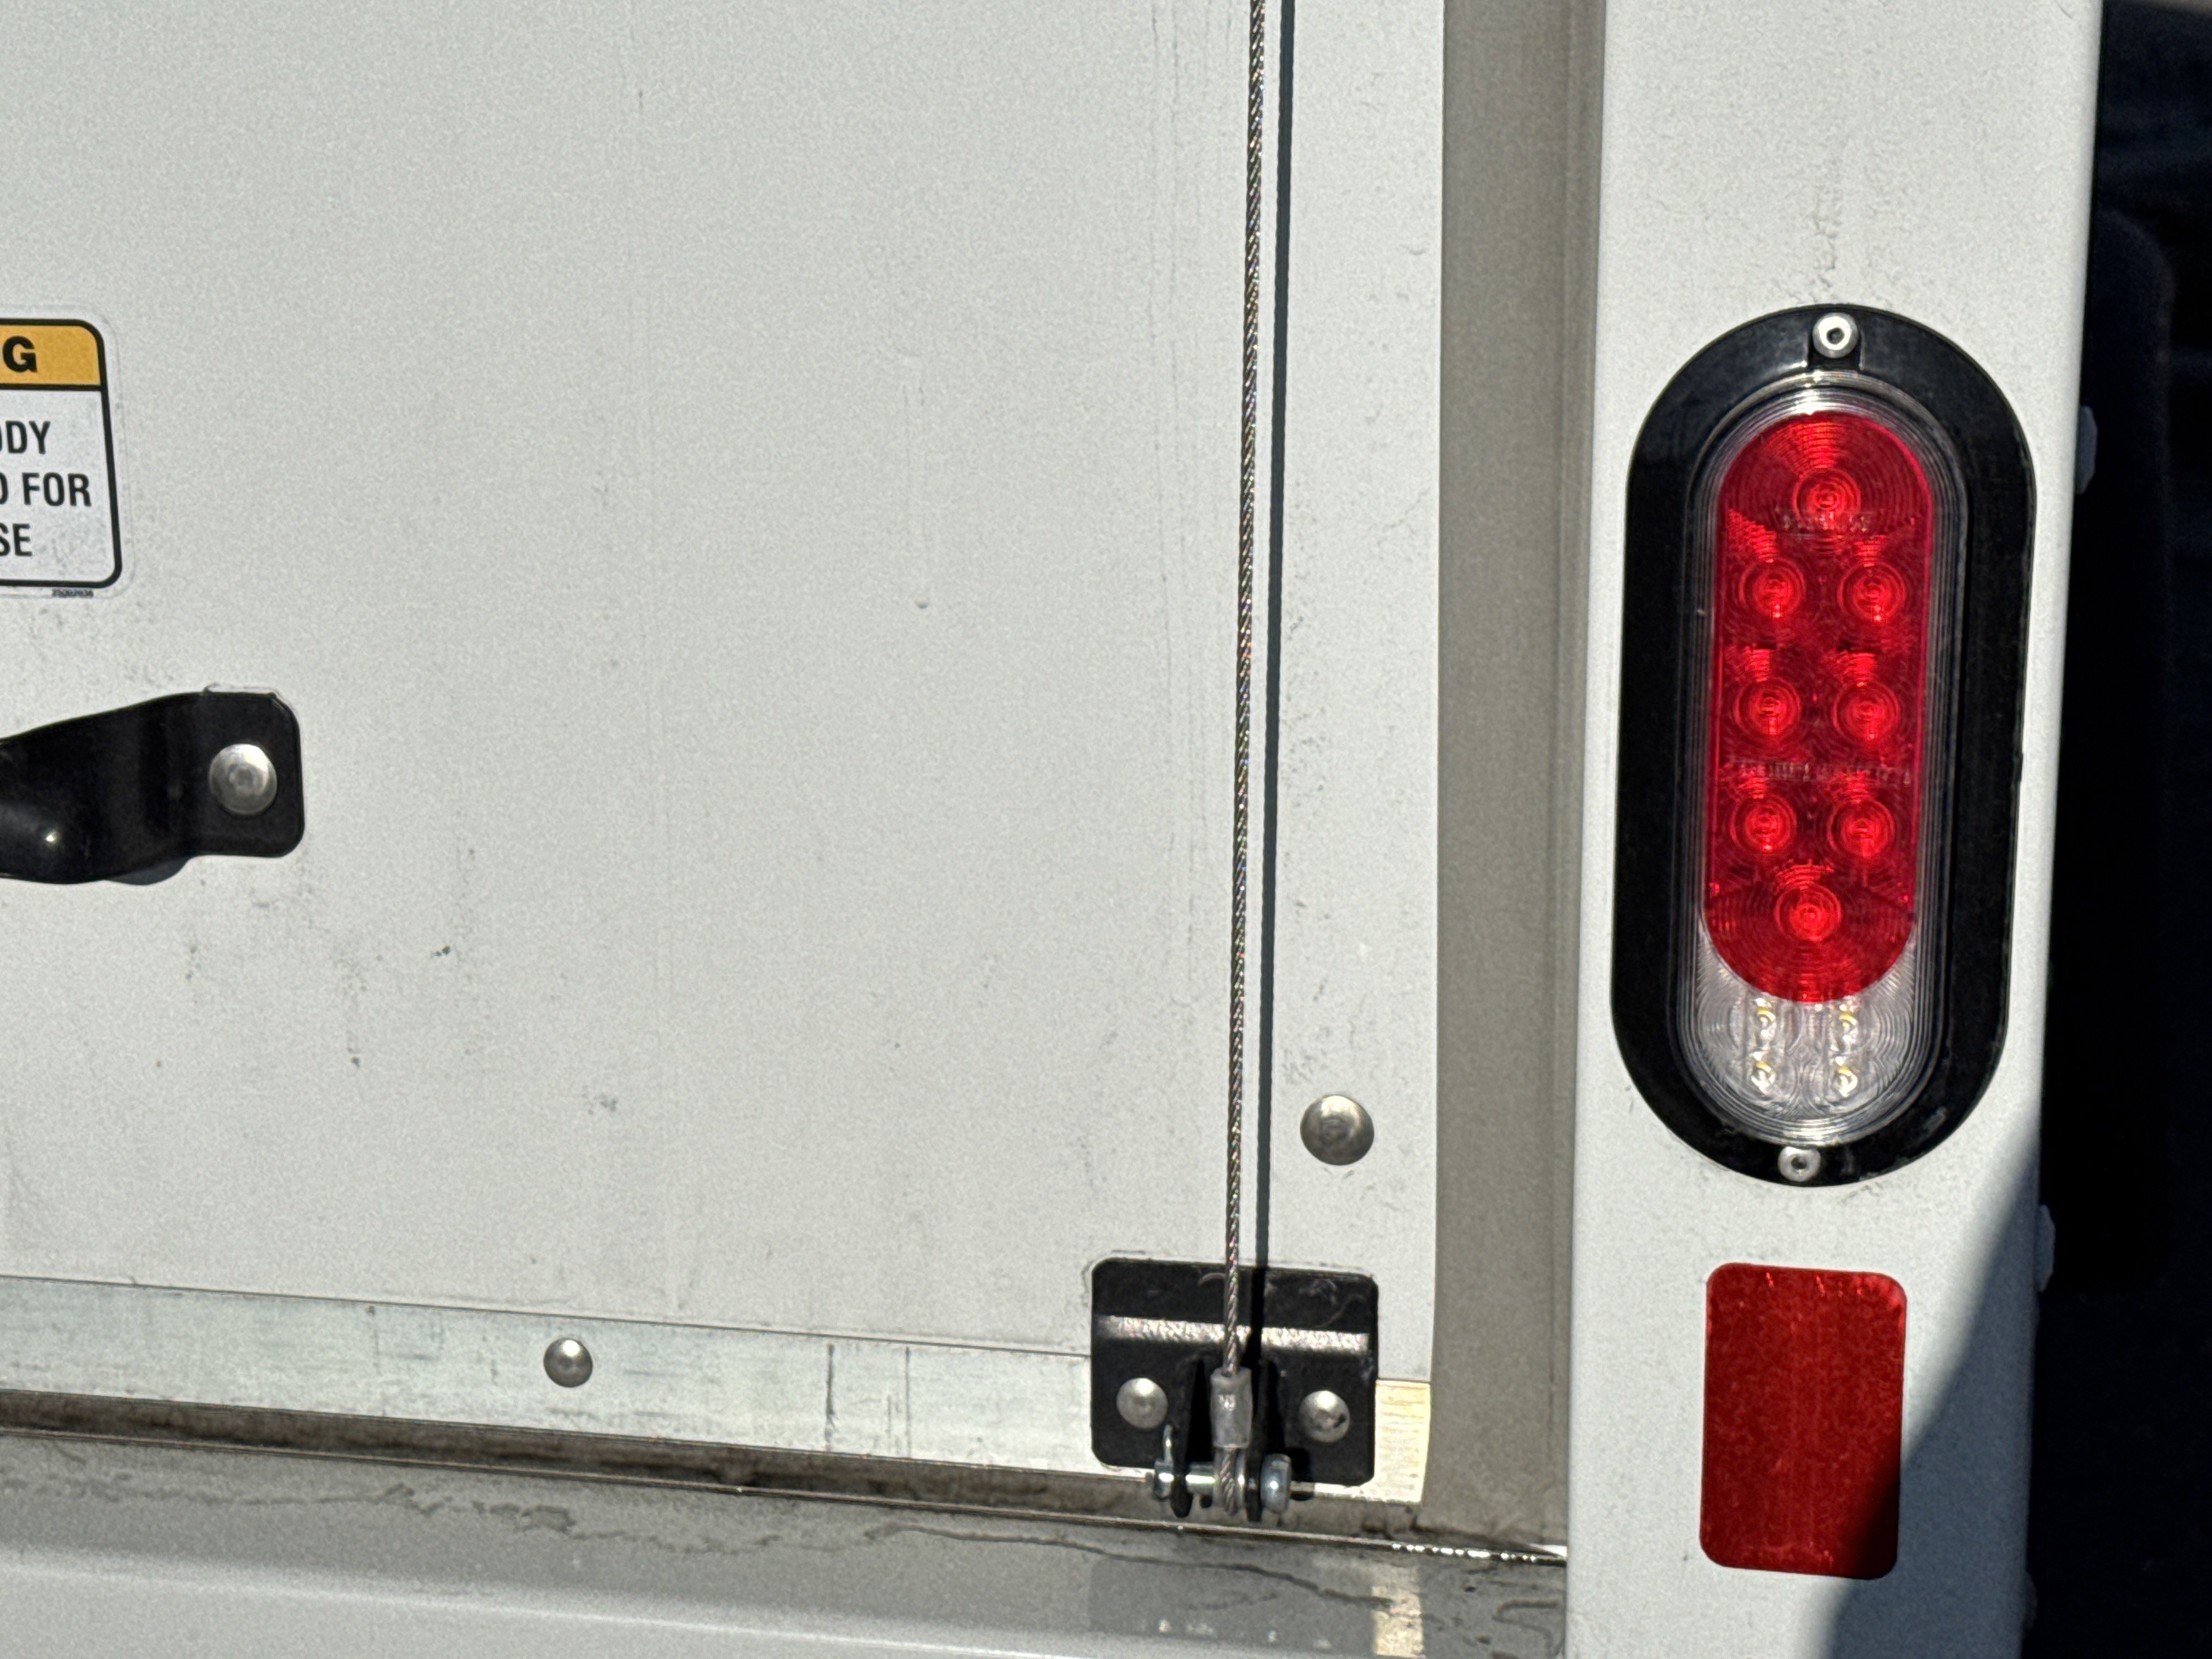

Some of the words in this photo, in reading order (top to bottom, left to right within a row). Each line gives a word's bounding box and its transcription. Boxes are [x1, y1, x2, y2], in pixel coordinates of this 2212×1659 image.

[2, 335, 38, 373] G
[0, 421, 50, 454] DY
[22, 472, 92, 507] FOR
